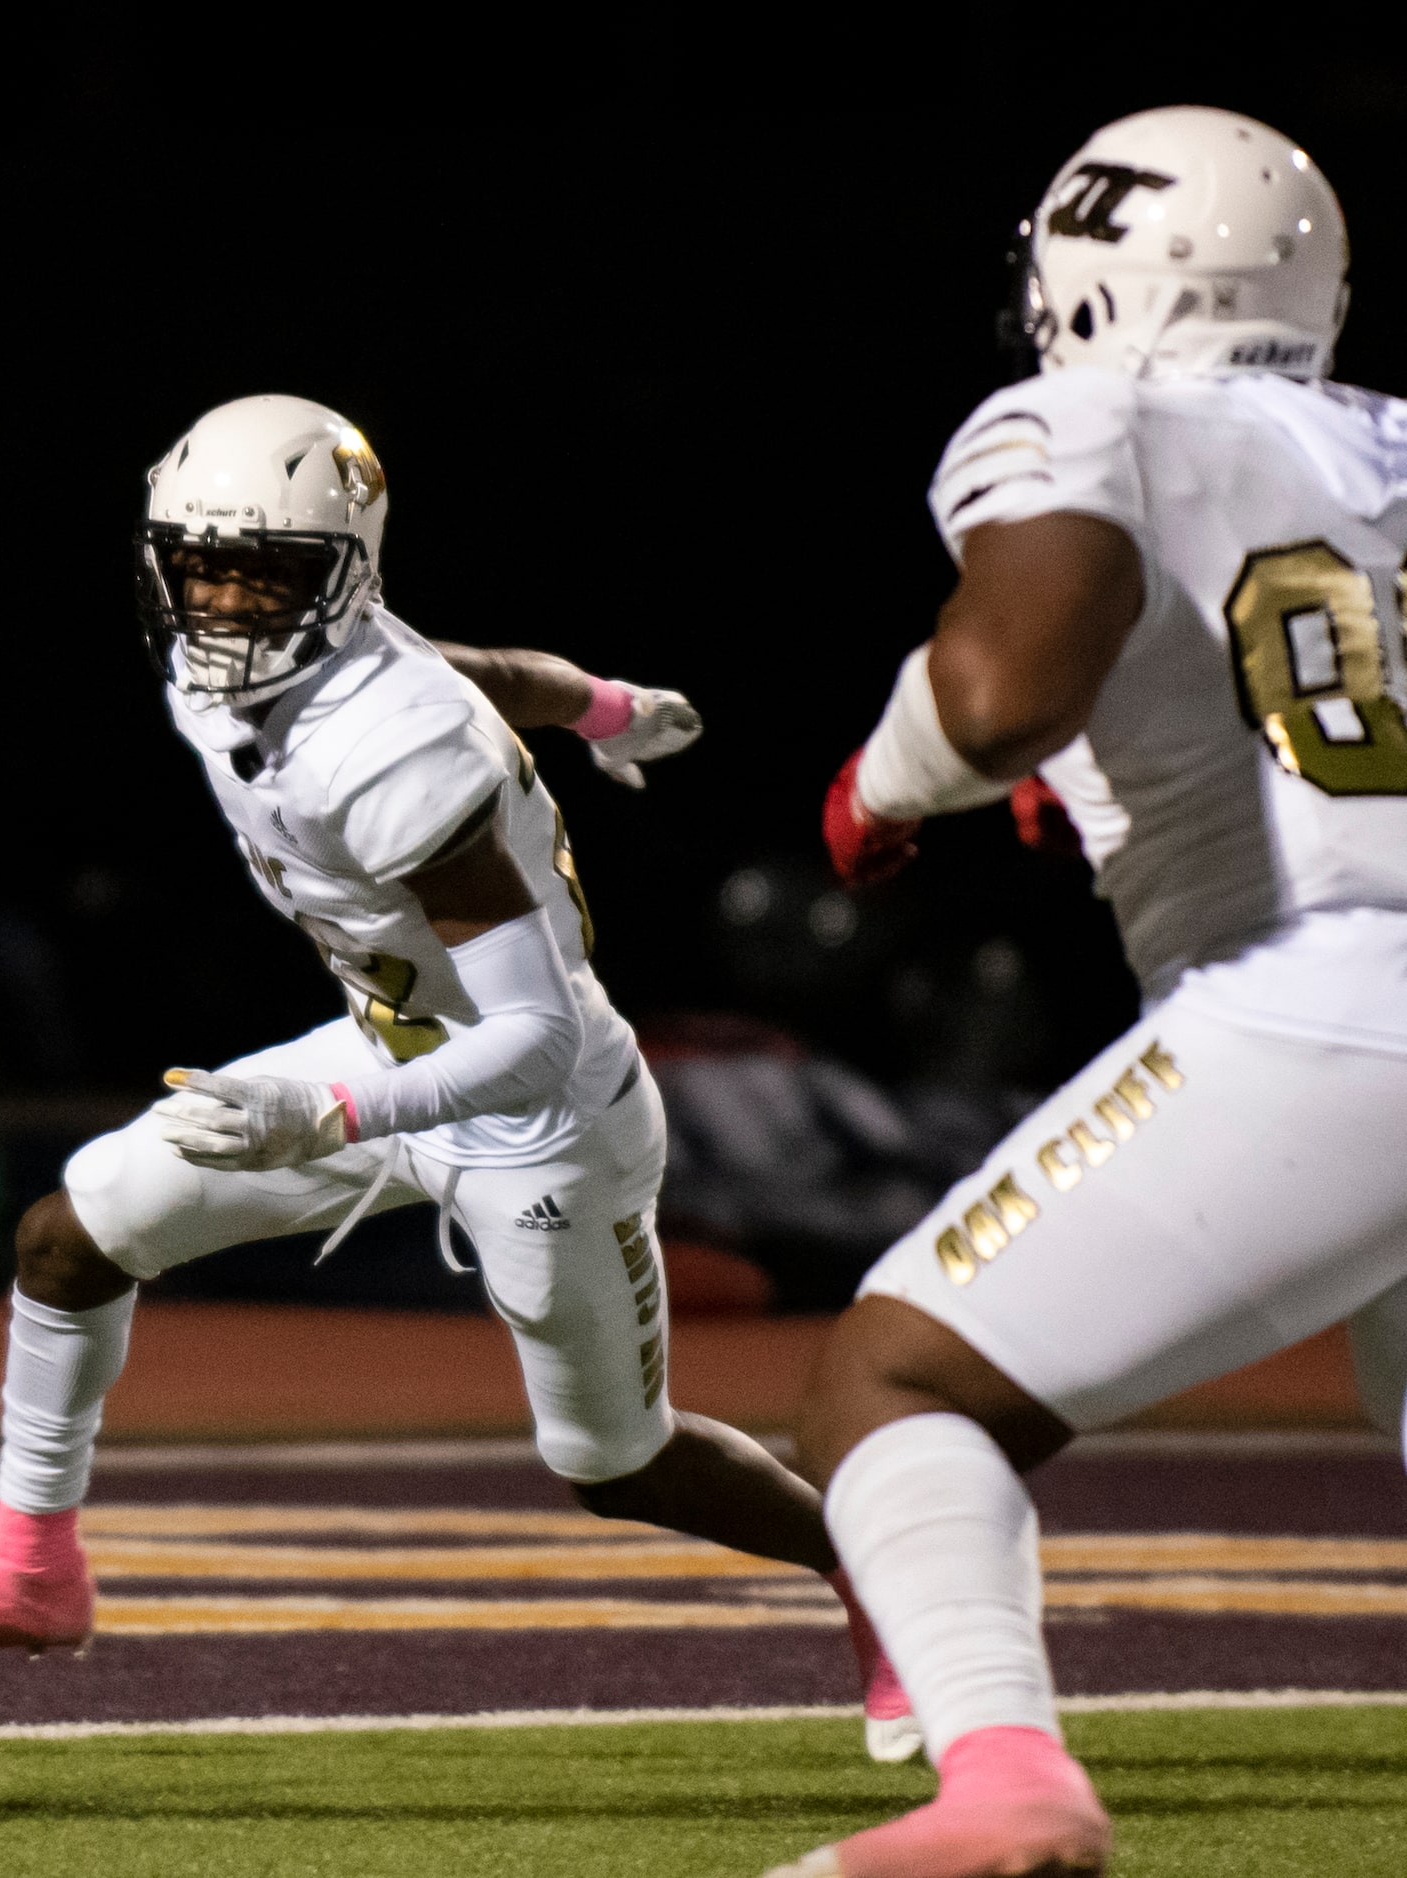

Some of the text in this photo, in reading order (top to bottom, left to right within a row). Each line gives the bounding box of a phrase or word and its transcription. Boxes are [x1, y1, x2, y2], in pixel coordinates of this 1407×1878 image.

[1224, 537, 1407, 798] 8
[934, 1037, 1185, 1286] OAK CLIFF
